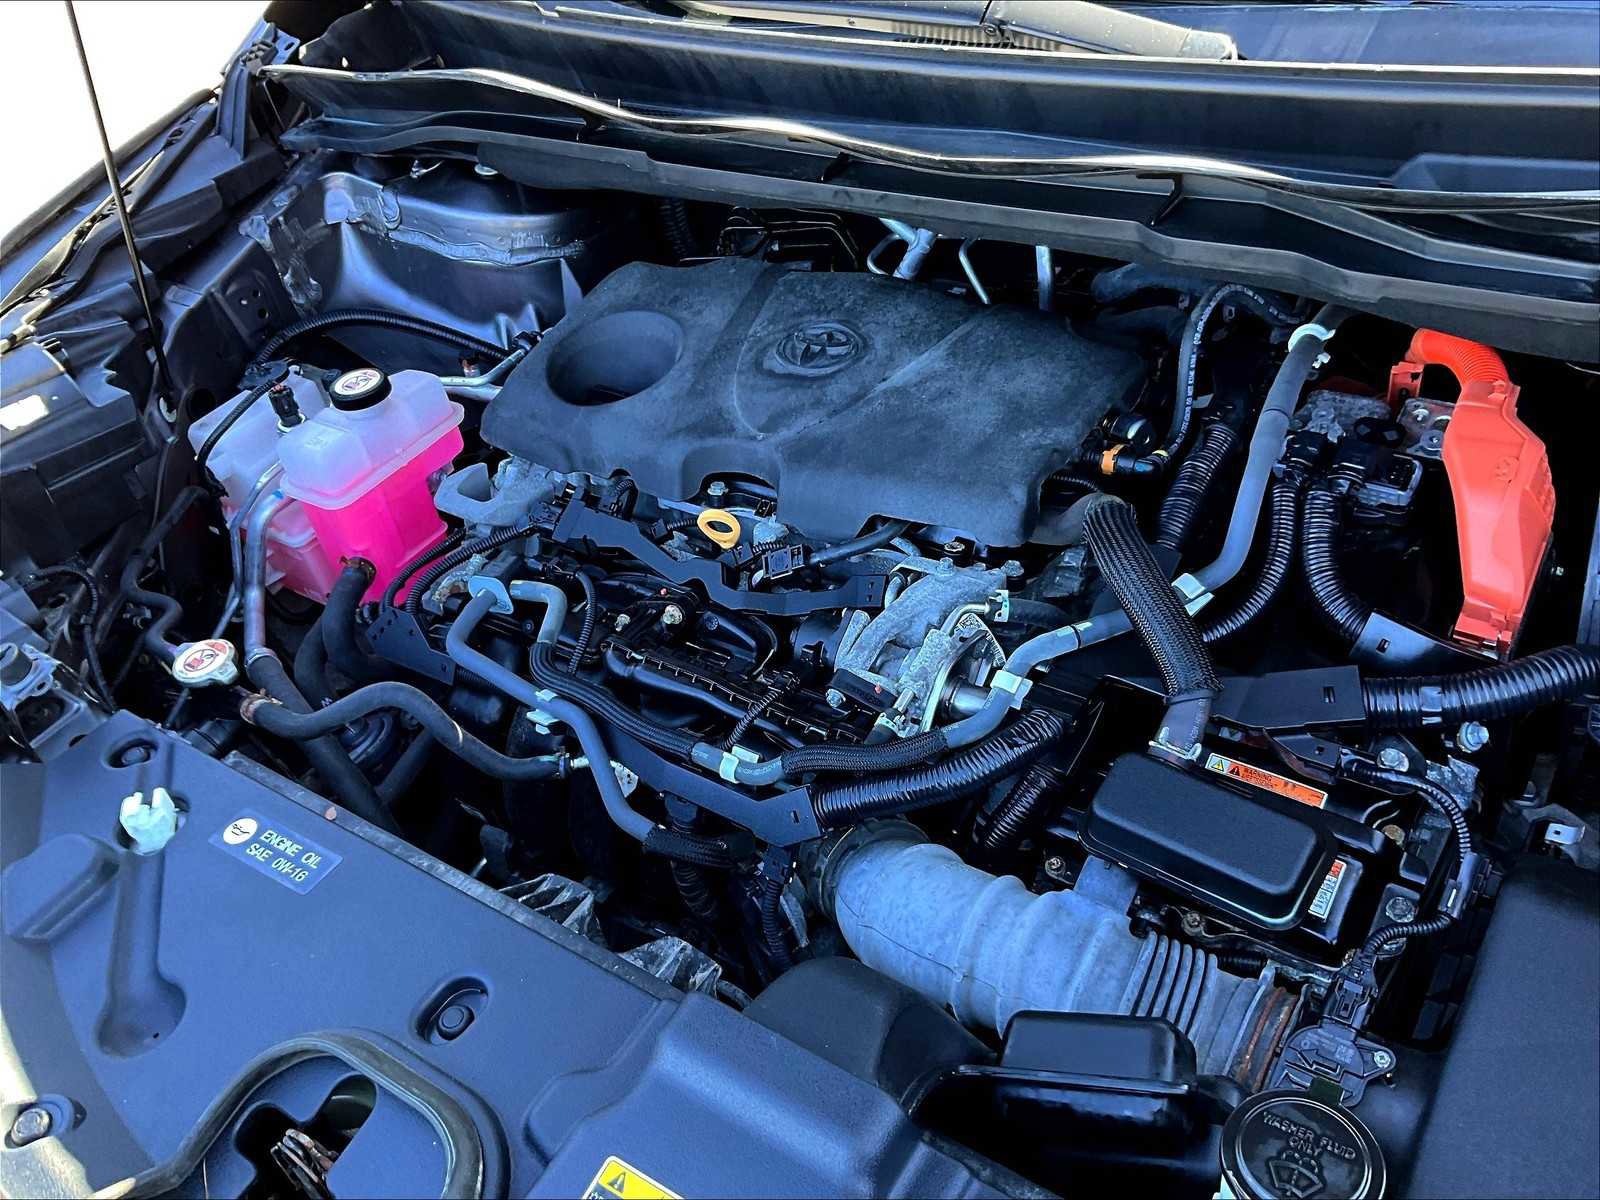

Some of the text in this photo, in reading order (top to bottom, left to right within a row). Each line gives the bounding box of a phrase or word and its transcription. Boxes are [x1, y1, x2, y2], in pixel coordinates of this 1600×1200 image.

[246, 843, 309, 882] SAE 0W-16
[259, 829, 322, 869] ENGINE OIL
[1289, 1135, 1322, 1157] ONLY
[1319, 1136, 1356, 1160] FLUID
